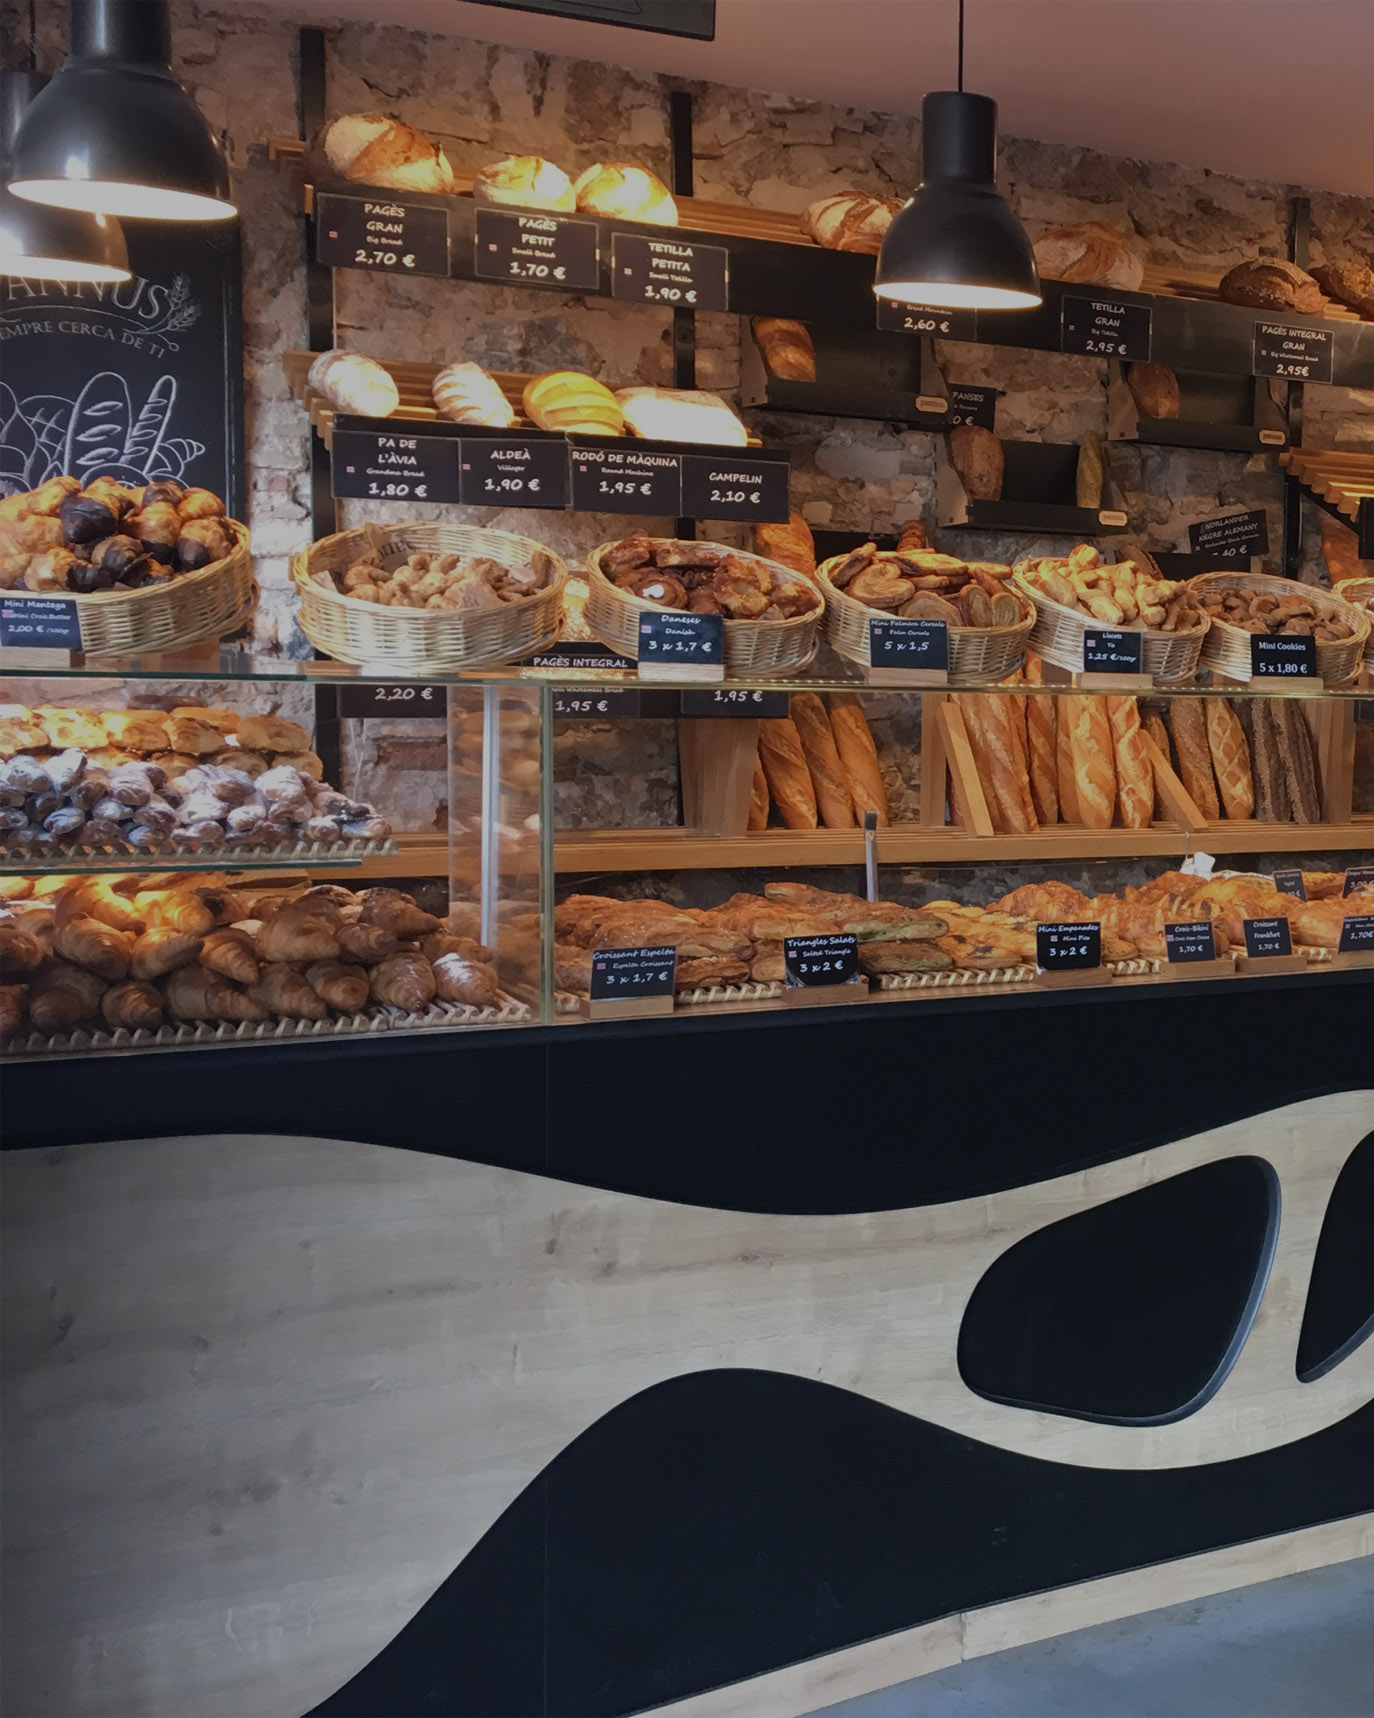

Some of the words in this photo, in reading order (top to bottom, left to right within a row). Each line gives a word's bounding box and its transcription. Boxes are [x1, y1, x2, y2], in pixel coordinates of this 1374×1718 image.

[364, 203, 406, 218] PAGÈS
[366, 221, 404, 234] GRAN
[518, 217, 557, 232] PAGÈS
[521, 233, 556, 247] PETIT
[648, 242, 694, 258] TETILLA
[355, 249, 398, 265] 2,70
[402, 254, 416, 268] €
[652, 257, 691, 272] PETITA
[509, 261, 549, 278] 1,70
[553, 266, 566, 280] €
[644, 284, 681, 300] 1,90
[685, 290, 697, 303] €
[1090, 302, 1125, 315] TETILLA
[903, 316, 936, 331] 2,60
[940, 321, 950, 333] €
[1094, 316, 1121, 328] GRAN
[58, 320, 115, 341] CERCA
[121, 332, 145, 349] DE
[149, 342, 165, 359] TI
[1262, 325, 1287, 337] PAGÈS
[1288, 328, 1327, 341] INTEGRAL
[1085, 340, 1115, 353] 2,95
[1118, 344, 1128, 355] €
[1282, 341, 1306, 351] GRAN
[378, 437, 396, 448] PA
[400, 439, 417, 449] DE
[378, 452, 418, 466] L'ÀVIA
[490, 448, 532, 460] ALDEÀ
[572, 451, 605, 462] RODÓ
[608, 454, 624, 464] DE
[626, 453, 679, 468] MÀQUINA
[709, 472, 763, 485] CAMPELIN
[368, 482, 410, 497] 1,80
[415, 485, 428, 498] €
[484, 478, 523, 493] 1,90
[528, 479, 540, 491] €
[599, 481, 636, 495] 1,95
[640, 483, 652, 495] €
[710, 490, 746, 504] 2,10
[750, 492, 761, 504] €
[1224, 522, 1259, 537] ALEMANY
[4, 600, 25, 608] Mini
[661, 614, 702, 625] Daneses
[8, 625, 34, 633] 2,00
[35, 625, 45, 633] €
[665, 626, 697, 636] Danish
[648, 640, 658, 650] 3
[675, 641, 698, 652] 1,7
[702, 642, 713, 652] €
[884, 641, 893, 650] 5
[908, 641, 930, 652] 1,5
[1258, 641, 1276, 650] Mini
[1277, 642, 1307, 651] Cookies
[533, 655, 570, 668] PAGÈS
[573, 656, 629, 669] INTEGRAL
[1259, 662, 1267, 673] 5
[1276, 663, 1298, 674] 1,80
[1300, 664, 1308, 674] €
[374, 687, 415, 701] 2,20
[420, 687, 434, 700] €
[713, 690, 748, 703] 1,95
[752, 690, 763, 702] €
[555, 700, 592, 713] 1,95
[596, 700, 609, 712] €
[1038, 925, 1057, 933] Mini
[788, 938, 828, 948] Triangles
[592, 950, 639, 960] Croissant
[640, 948, 676, 958] Espelta
[800, 963, 809, 973] 3
[822, 961, 832, 971] 2
[834, 960, 844, 970] €
[606, 975, 616, 984] 3
[631, 973, 655, 983] 1,7
[658, 971, 669, 981] €
